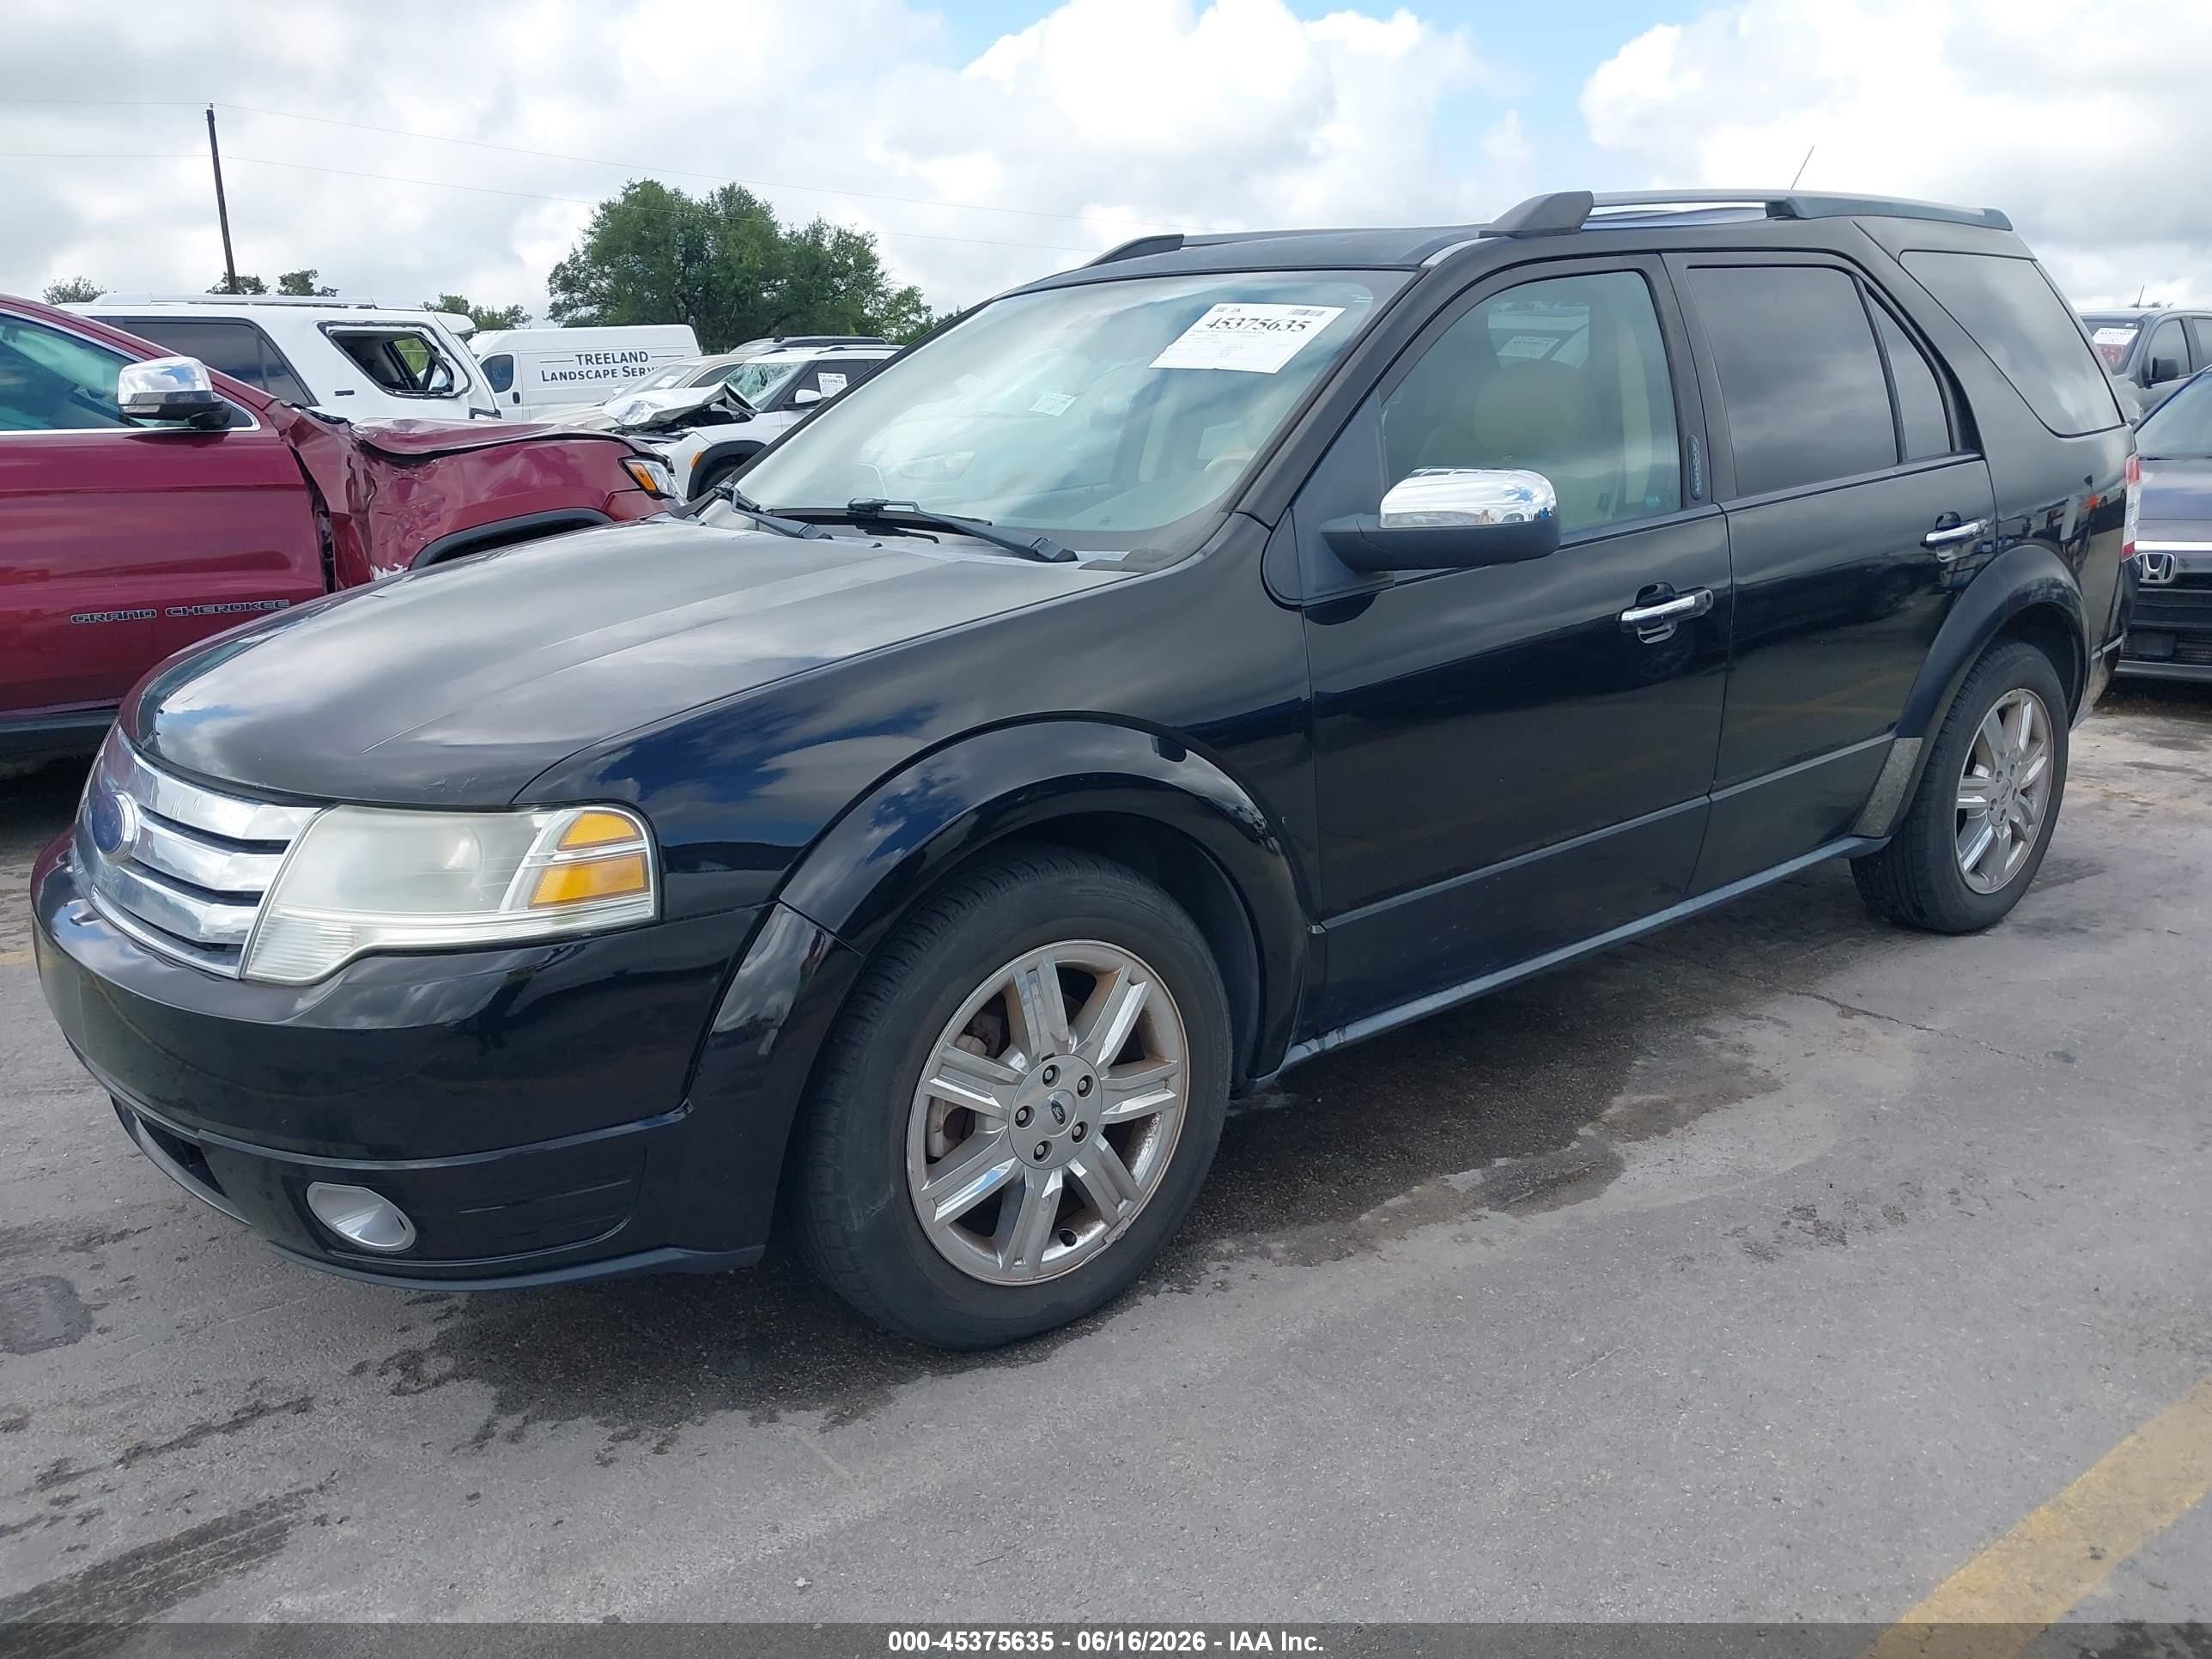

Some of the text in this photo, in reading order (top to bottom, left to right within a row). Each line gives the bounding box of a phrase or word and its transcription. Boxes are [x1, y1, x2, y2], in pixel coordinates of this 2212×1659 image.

[1206, 317, 1312, 332] 45375635
[575, 350, 648, 366] TREELAND
[542, 368, 618, 382] LANDSCAPE
[70, 599, 290, 624] GRAND CHEROKEE
